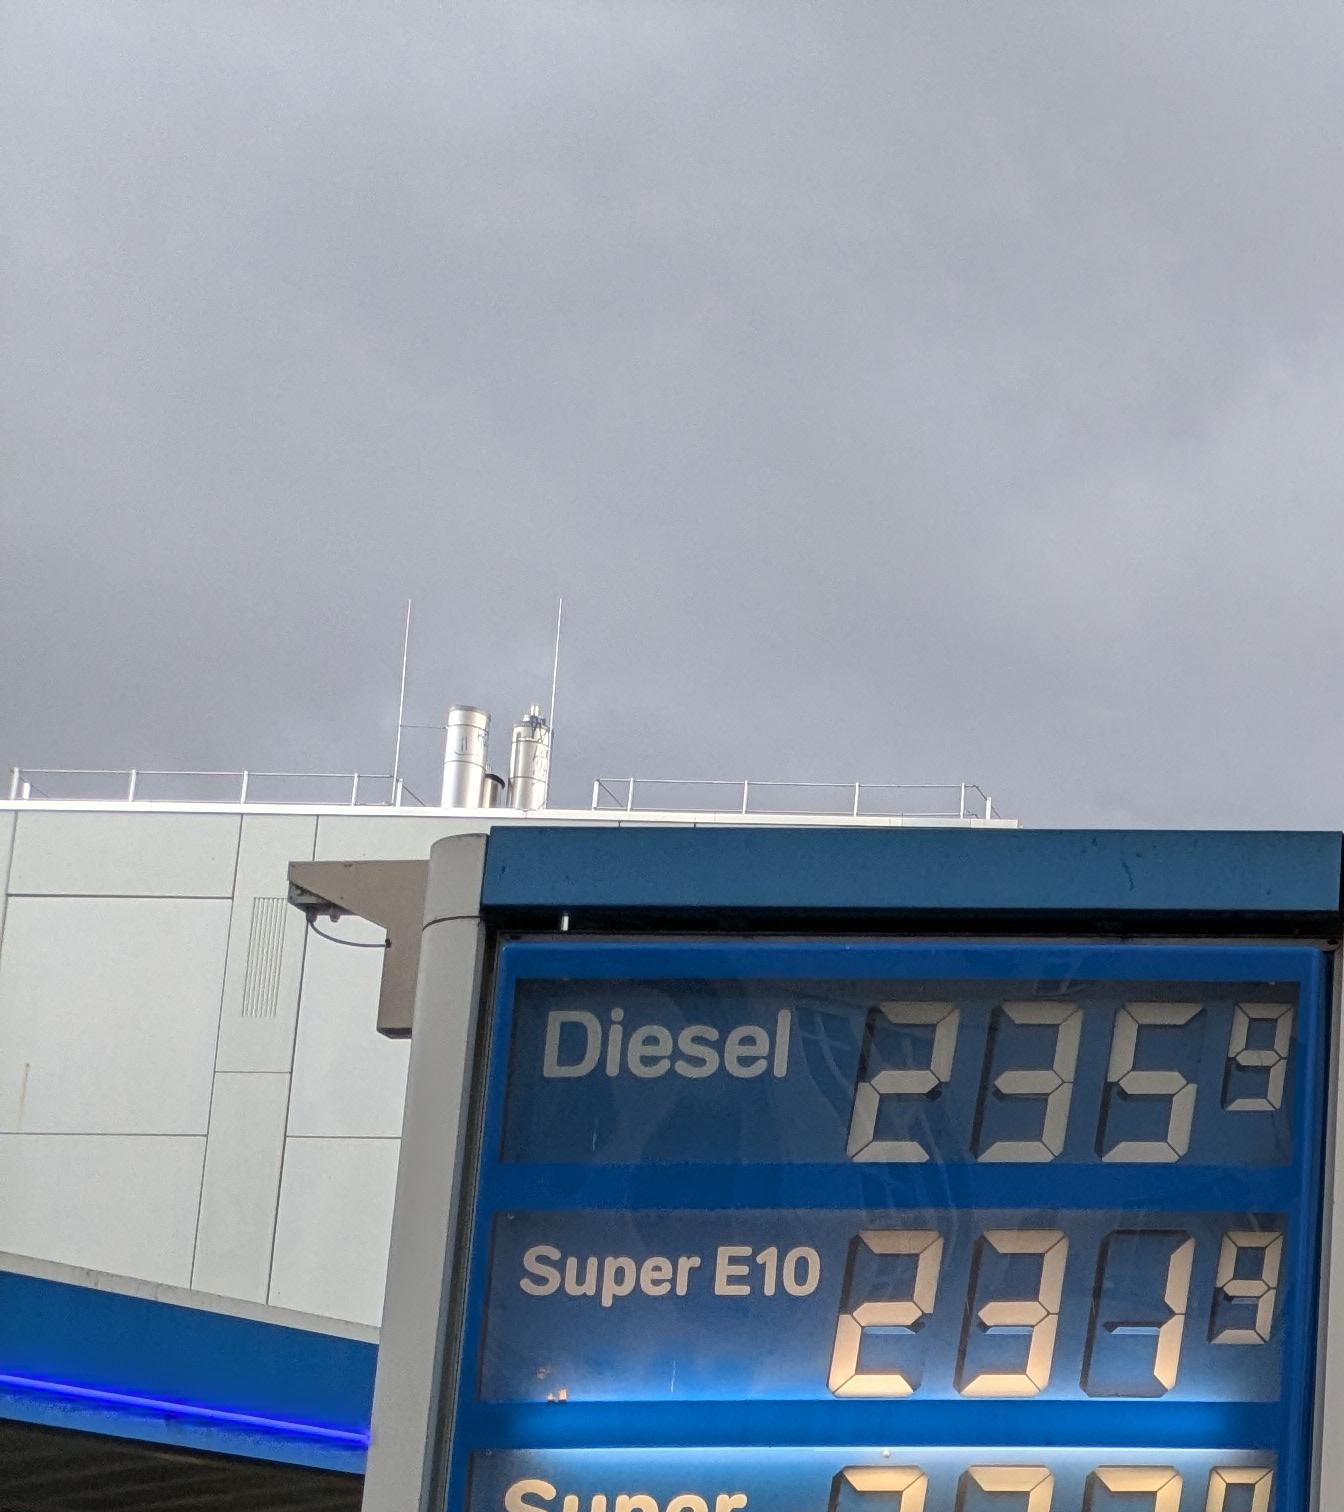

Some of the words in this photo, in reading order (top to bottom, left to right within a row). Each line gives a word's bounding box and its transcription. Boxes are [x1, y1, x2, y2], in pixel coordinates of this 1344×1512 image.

[542, 1008, 791, 1079] Diesel
[519, 1246, 699, 1307] Super
[714, 1246, 821, 1297] E10
